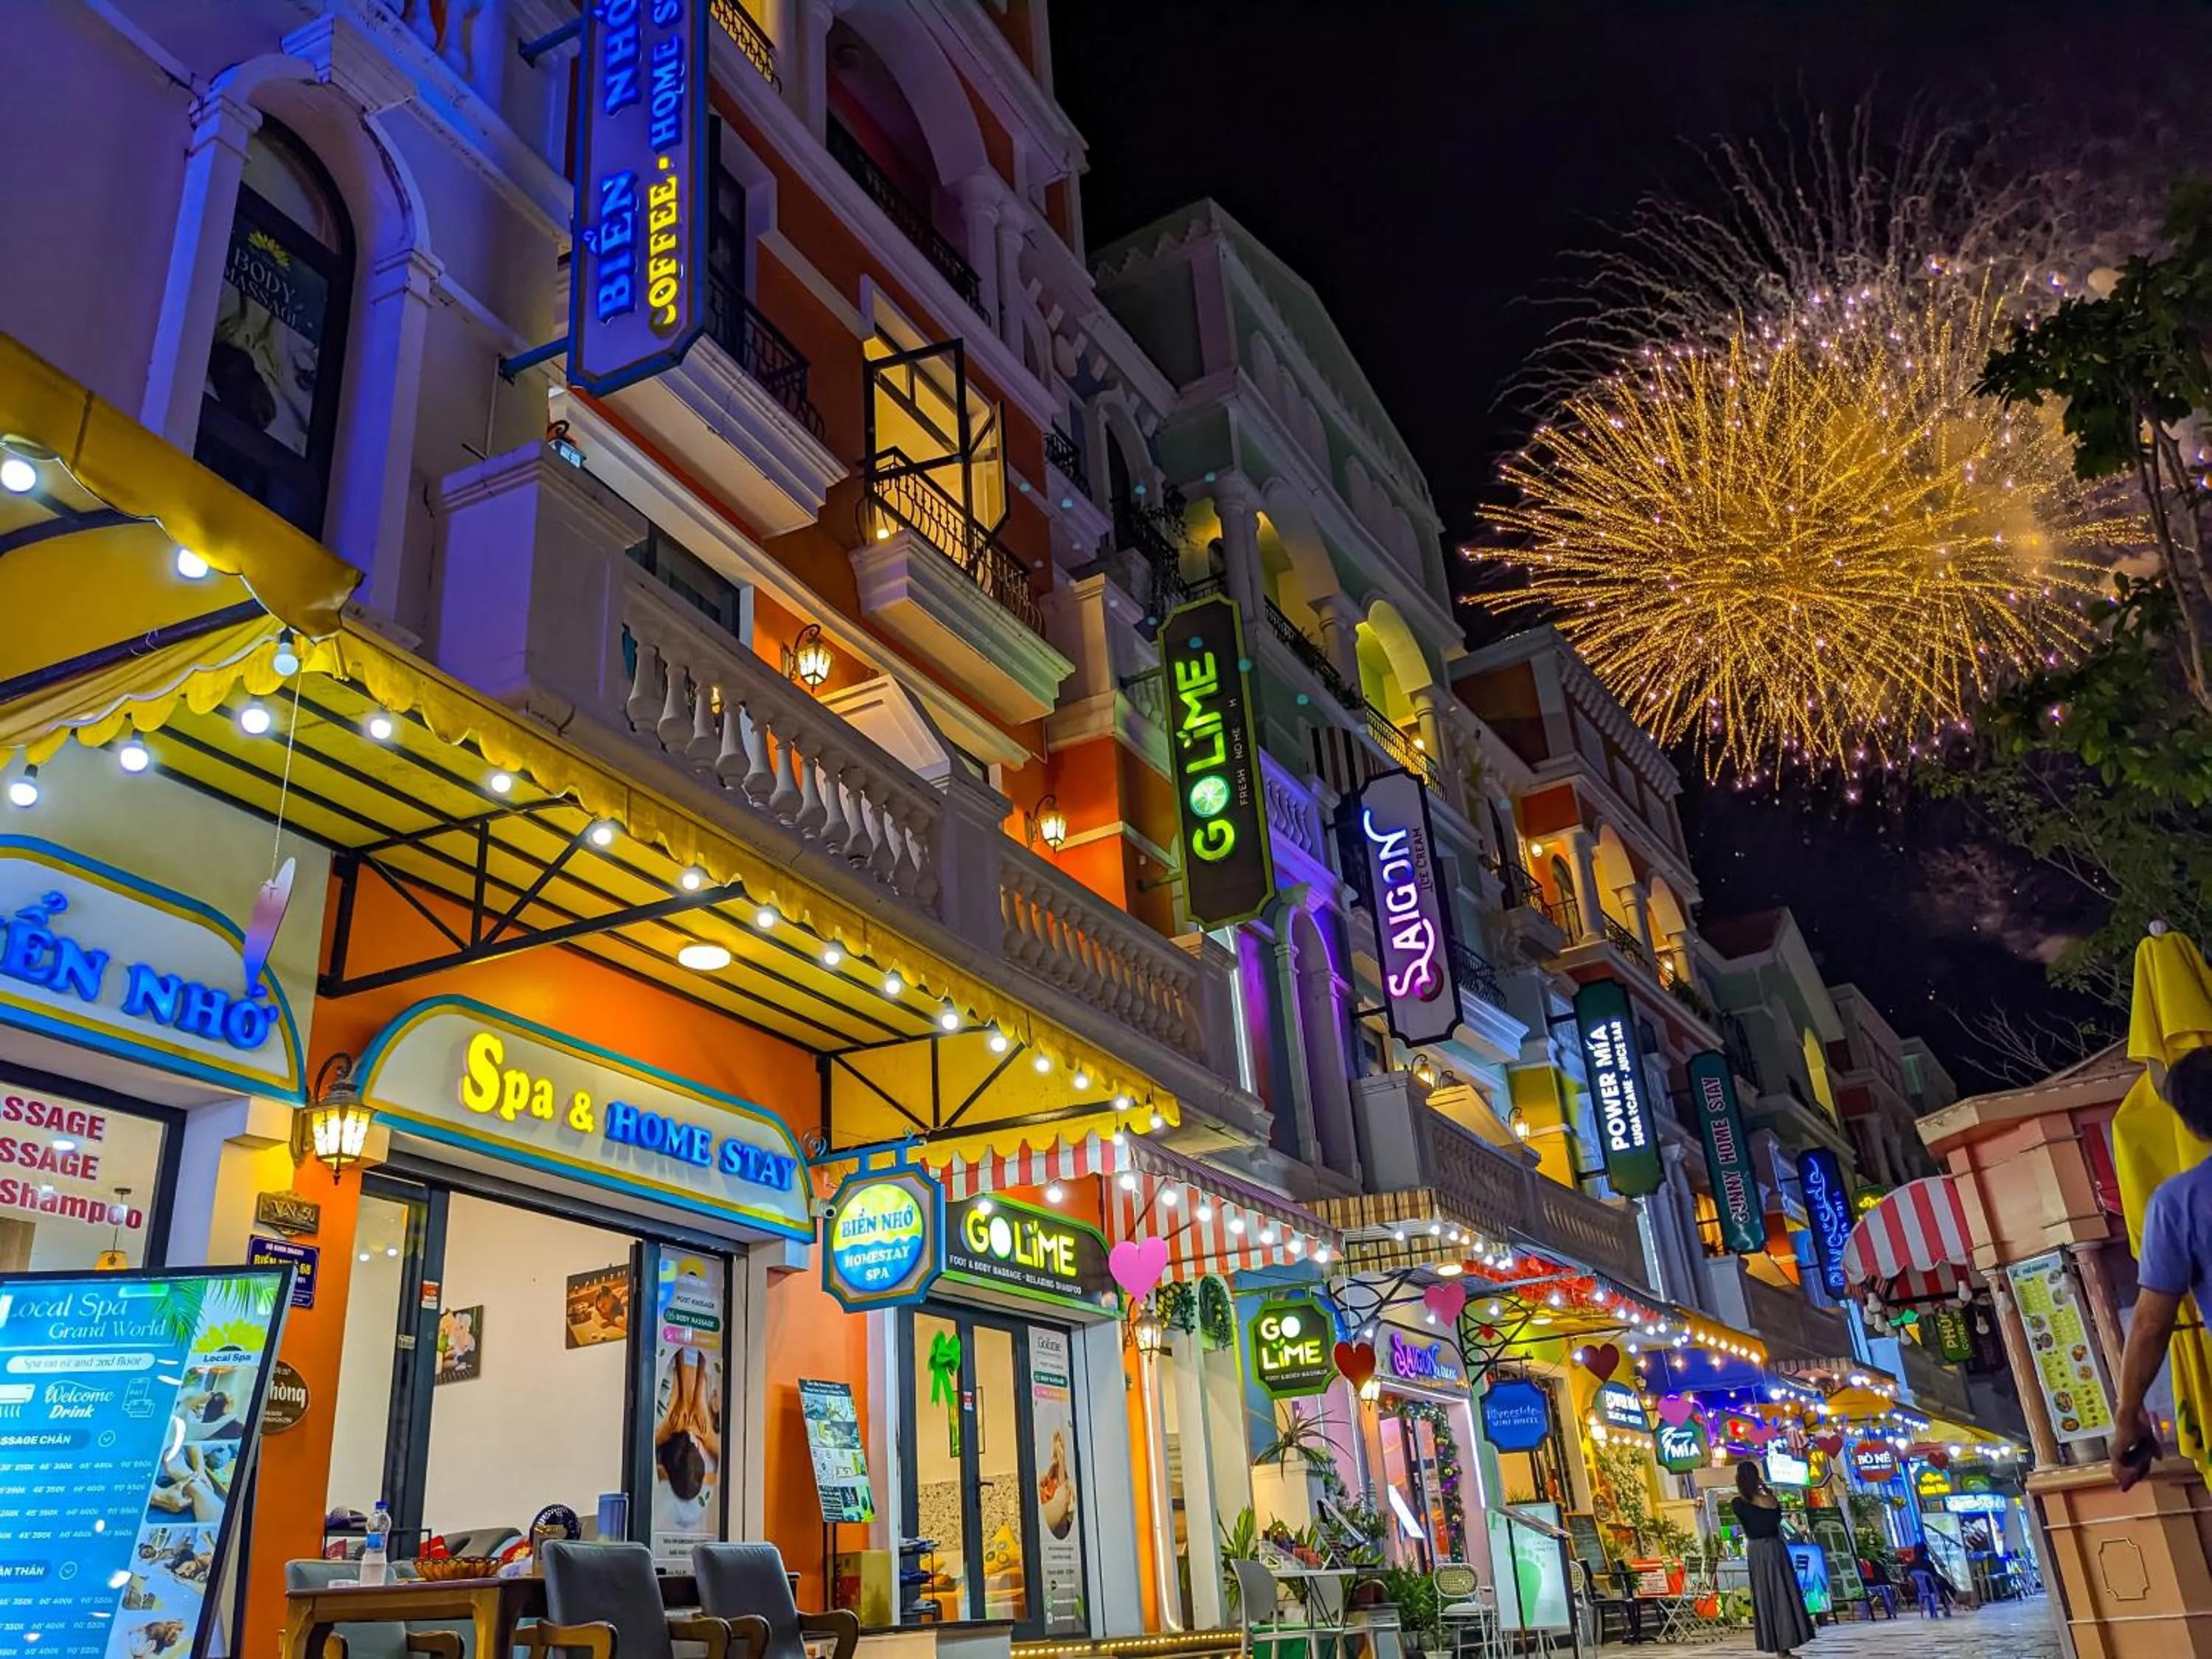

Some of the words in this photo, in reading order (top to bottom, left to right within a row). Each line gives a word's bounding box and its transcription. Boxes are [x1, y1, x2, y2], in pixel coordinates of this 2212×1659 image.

[653, 0, 681, 25] S
[650, 35, 681, 152] HOME
[234, 247, 296, 302] BODY
[1412, 827, 1428, 869] CREAM
[1420, 871, 1434, 893] ICE
[1363, 809, 1436, 998] SAIGON
[0, 890, 110, 1002] ỂN
[1585, 1024, 1614, 1068] MÍA
[1610, 1020, 1624, 1042] BAR
[1613, 1042, 1631, 1072] JUICE
[1702, 1077, 1726, 1112] STAY
[0, 1095, 105, 1142] SSAGE
[462, 1032, 554, 1121] Spa
[567, 1090, 595, 1133] &
[605, 1101, 712, 1166] HOME
[719, 1136, 798, 1192] STAY
[1598, 1071, 1630, 1152] POWER
[1622, 1079, 1645, 1147] SUGARCANE
[1711, 1116, 1738, 1165] HOME
[0, 1178, 142, 1229] Shampoo
[1722, 1170, 1750, 1224] SUNNY
[844, 1245, 911, 1268] HOMESTAY
[949, 1254, 967, 1268] FOOT
[974, 1261, 992, 1273] BODY
[992, 1265, 1023, 1281] MASSAGE
[865, 1267, 890, 1281] SPA
[12, 1293, 73, 1318] ocal
[78, 1293, 128, 1324] Spa
[49, 1321, 105, 1340] Grand
[113, 1319, 167, 1337] World
[1260, 1315, 1301, 1340] GO
[203, 1354, 231, 1363] Local
[232, 1353, 251, 1363] Spa
[45, 1383, 116, 1404] Welcome
[268, 1380, 307, 1409] hòng
[49, 1404, 95, 1419] Drink
[1669, 1439, 1701, 1458] MÍA
[1857, 1452, 1874, 1464] BÒ
